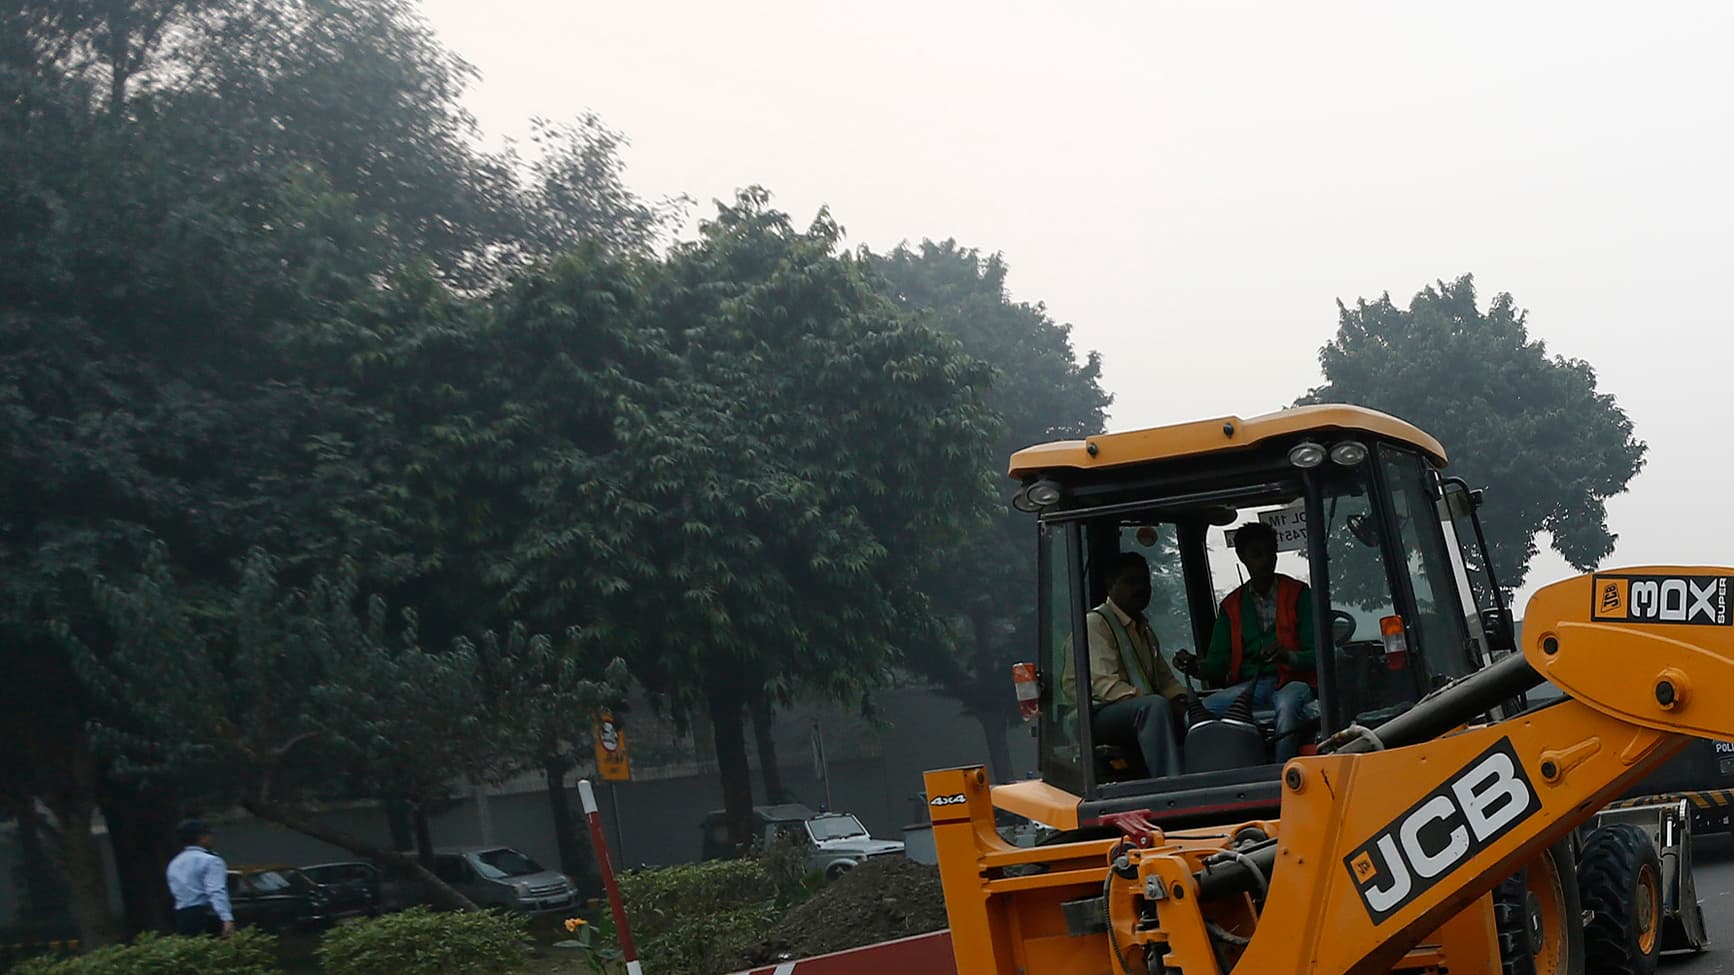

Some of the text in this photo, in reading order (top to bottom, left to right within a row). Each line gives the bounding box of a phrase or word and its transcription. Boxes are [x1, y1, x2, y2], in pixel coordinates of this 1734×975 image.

[1602, 582, 1621, 611] JCB
[1631, 578, 1718, 623] 3DX
[1717, 577, 1727, 624] SUPER
[1364, 752, 1530, 912] JCB
